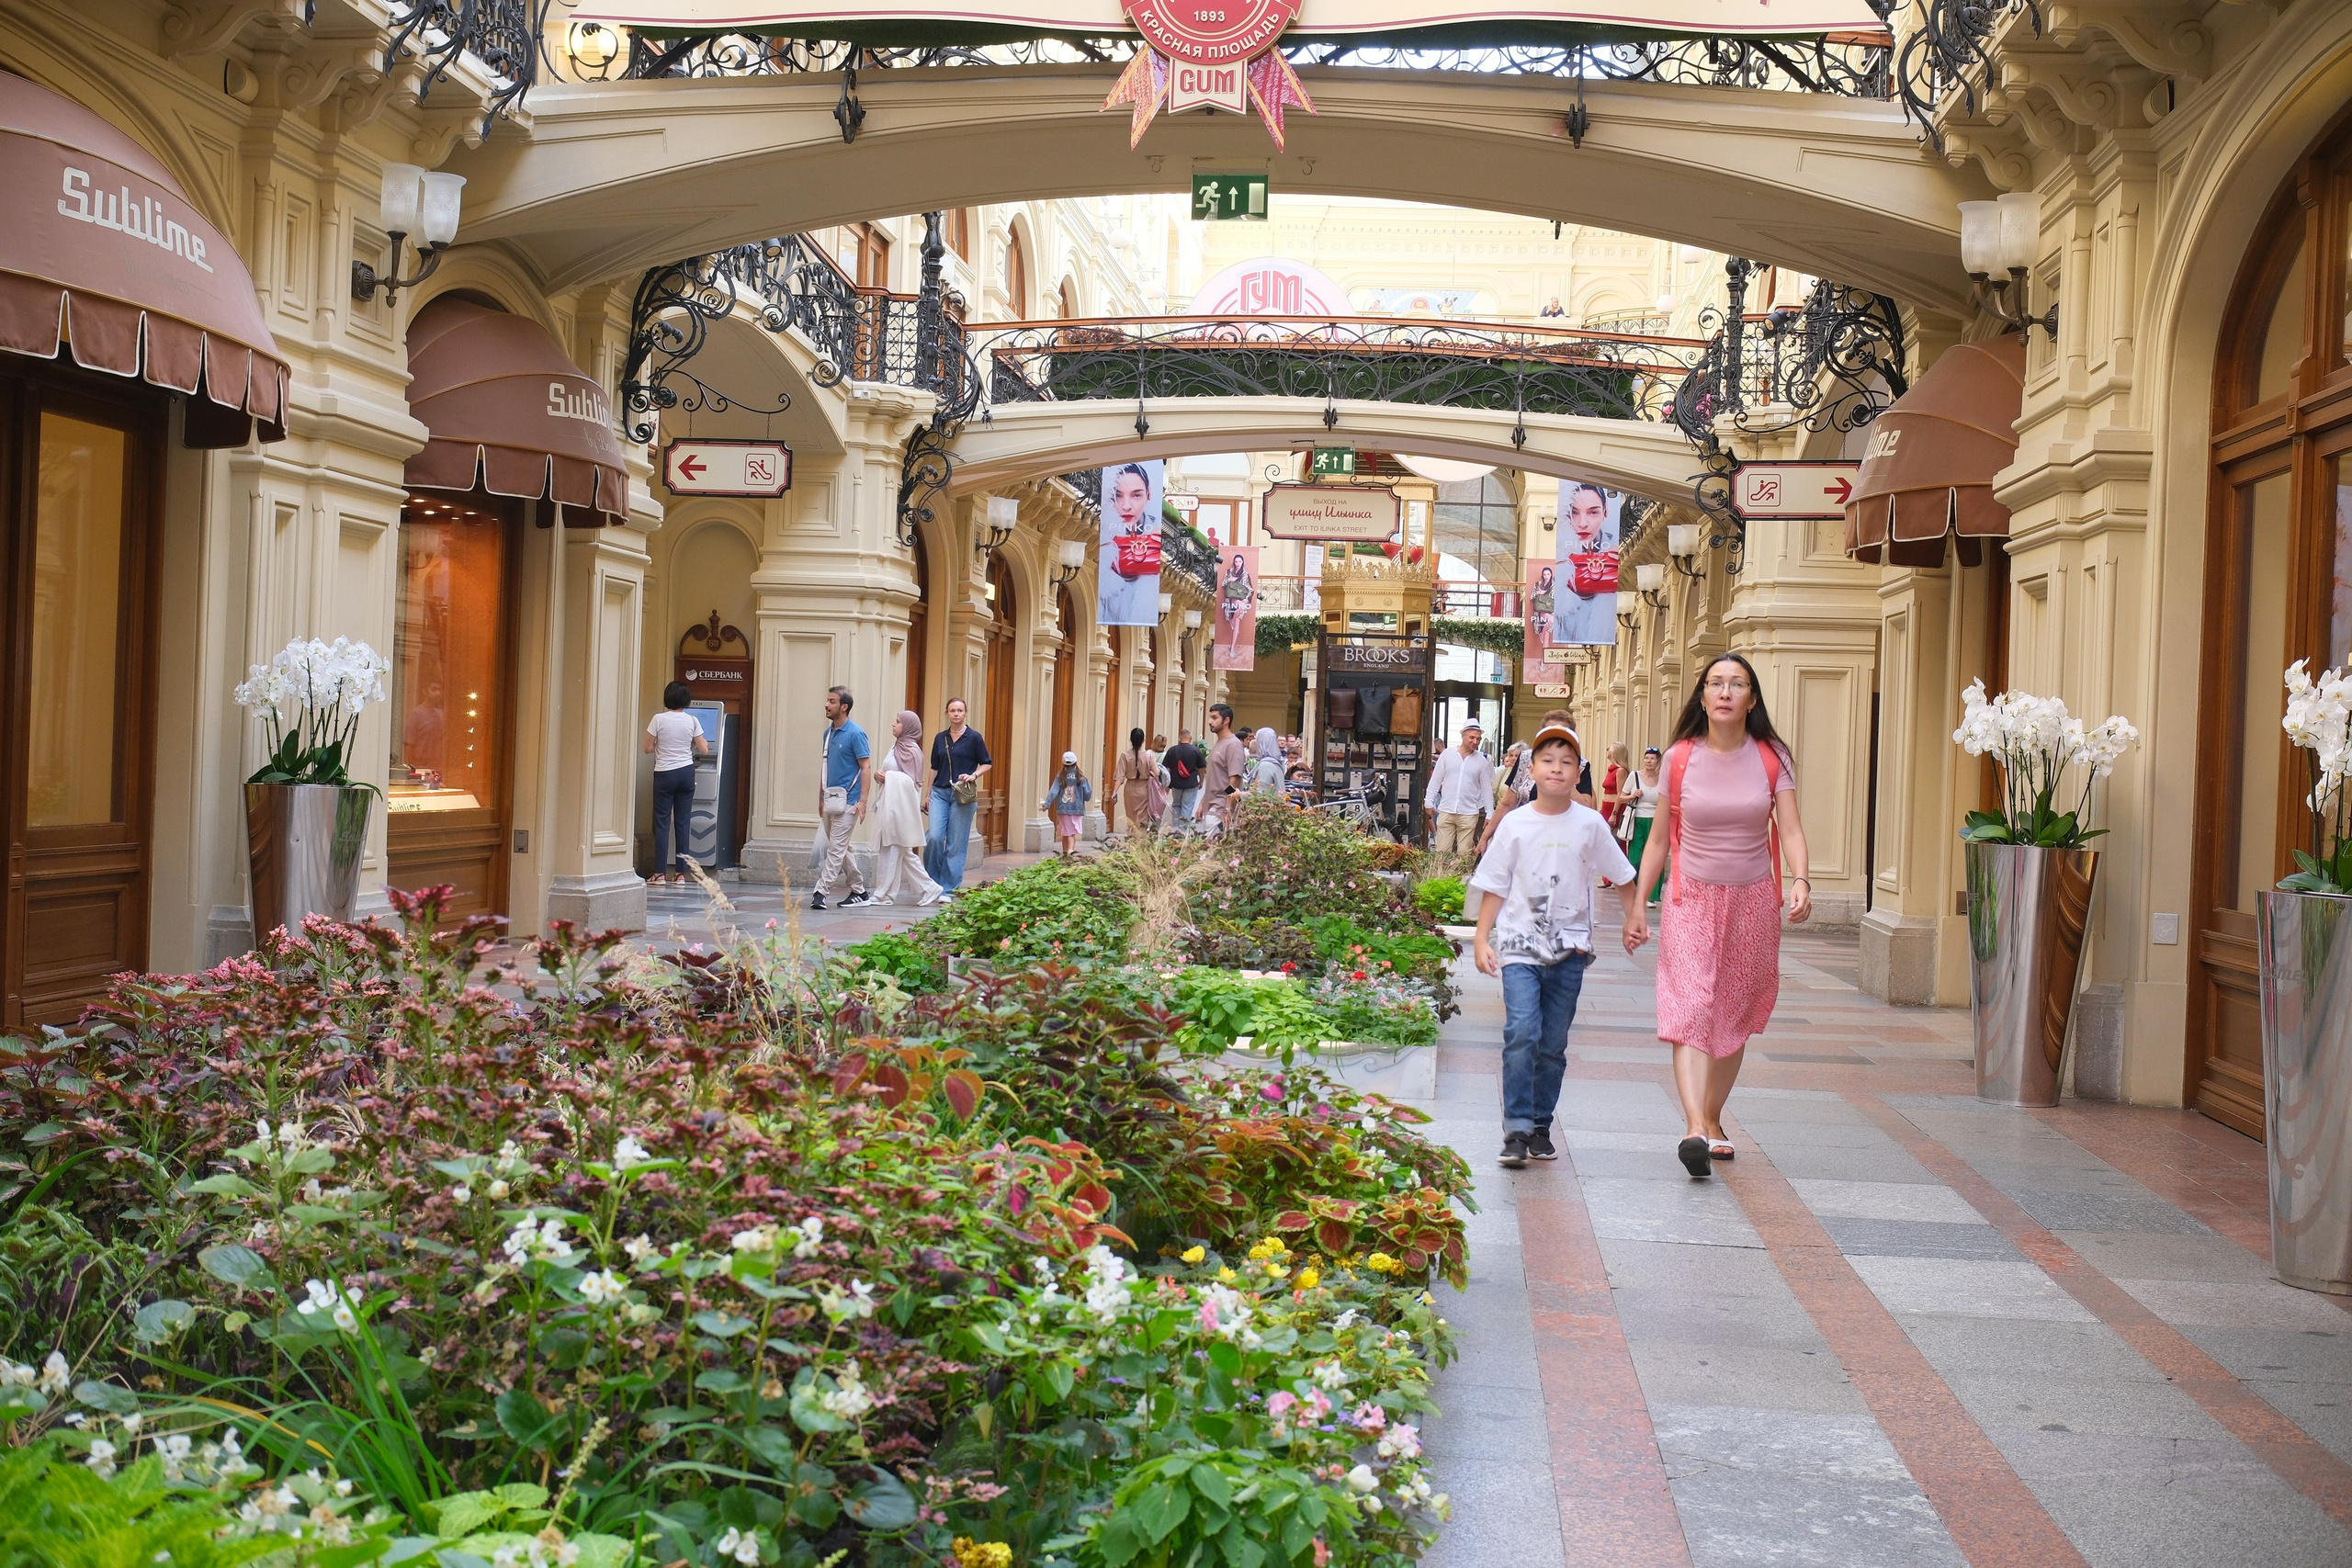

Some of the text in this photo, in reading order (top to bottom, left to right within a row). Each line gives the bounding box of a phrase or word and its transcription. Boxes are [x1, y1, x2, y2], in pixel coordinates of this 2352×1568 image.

[1193, 10, 1226, 22] 1893
[1140, 9, 1280, 59] КРАСНАЯ ПЛОЩАДЬ
[1180, 69, 1237, 95] GUM
[57, 166, 214, 274] Sublime
[1240, 270, 1303, 314] ГУМ
[1289, 505, 1373, 521] улицу Ильинка
[1109, 523, 1153, 532] PINKO
[1565, 540, 1611, 550] PINKO
[1344, 648, 1409, 663] BROOKS
[698, 670, 743, 679] СБЕРБАНК
